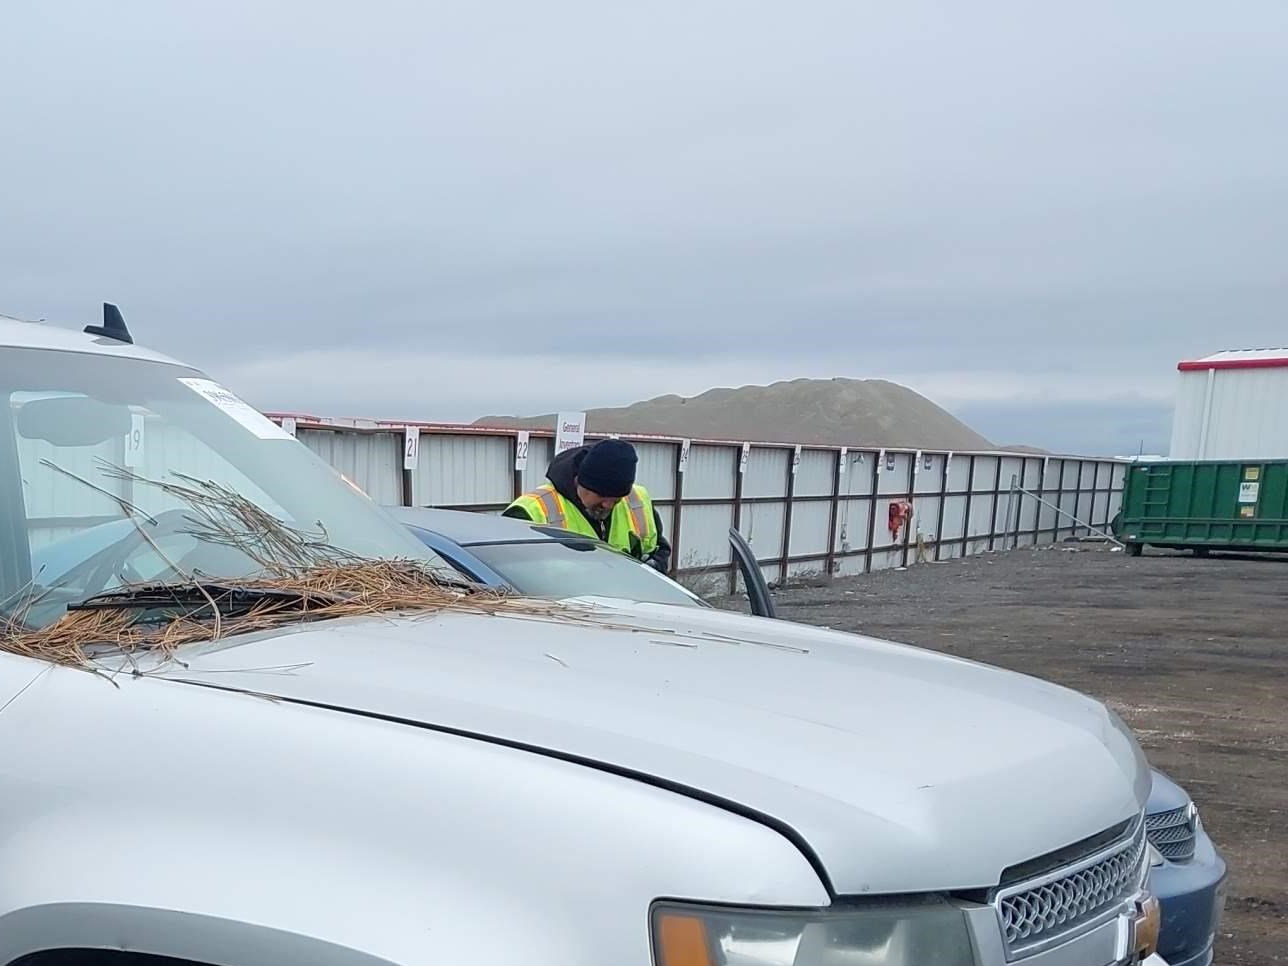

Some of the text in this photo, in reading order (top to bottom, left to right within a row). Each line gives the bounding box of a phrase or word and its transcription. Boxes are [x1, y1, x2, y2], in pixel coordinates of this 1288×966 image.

[562, 421, 581, 433] General
[128, 429, 141, 451] 19
[407, 437, 417, 457] 21
[517, 441, 528, 459] 22
